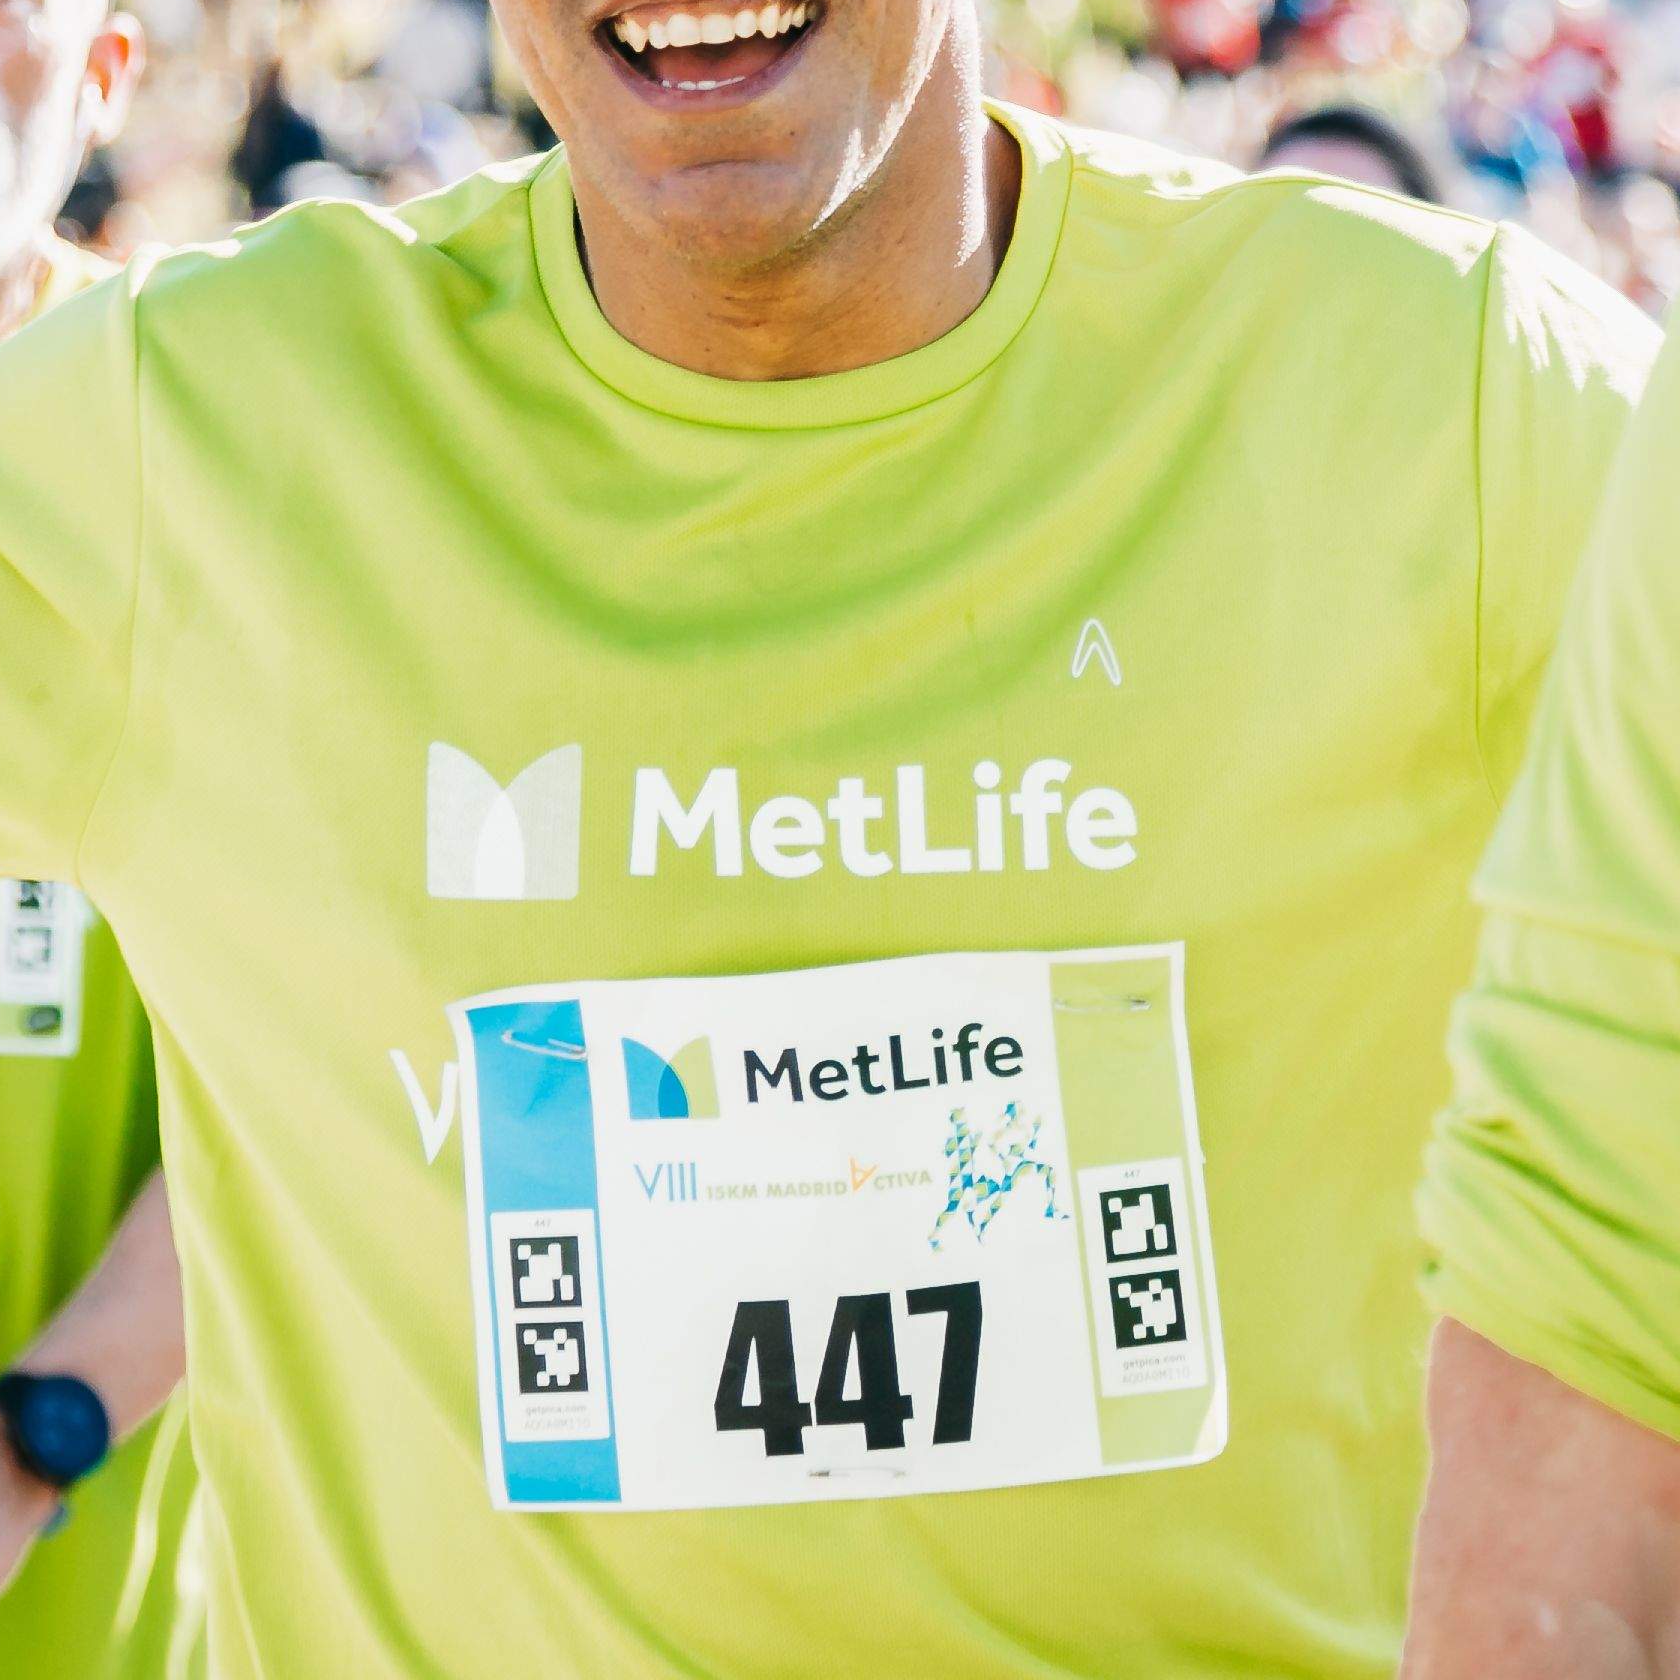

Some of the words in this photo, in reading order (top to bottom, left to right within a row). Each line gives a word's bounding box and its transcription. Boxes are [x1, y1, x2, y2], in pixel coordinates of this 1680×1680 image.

[629, 758, 1139, 878] MetLife
[743, 1022, 1025, 1104] MetLife
[631, 1162, 698, 1202] VIII
[706, 1183, 758, 1201] 15KM
[765, 1179, 848, 1199] MADRID
[713, 1280, 983, 1457] 447
